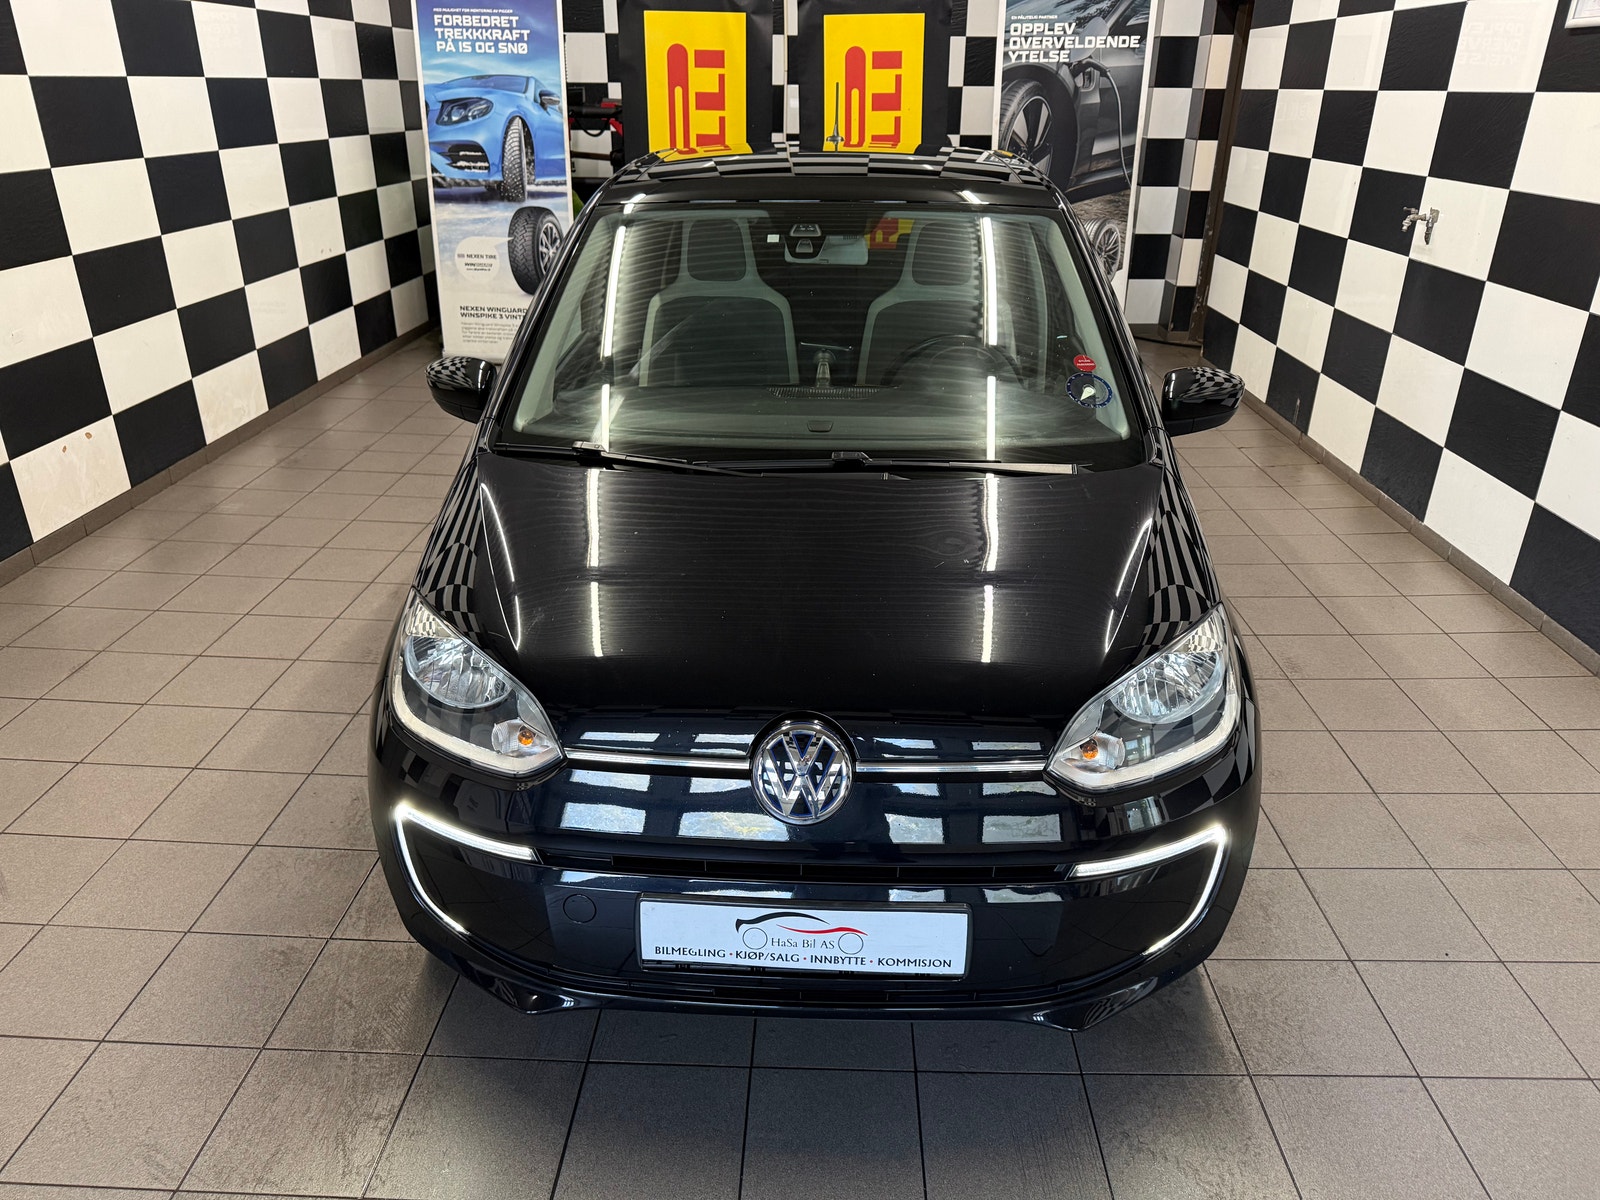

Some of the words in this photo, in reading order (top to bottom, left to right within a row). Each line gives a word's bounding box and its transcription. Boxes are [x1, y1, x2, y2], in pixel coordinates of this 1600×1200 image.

[434, 15, 519, 27] FORBEDRET
[435, 28, 530, 41] TREKKKRAFT
[1010, 23, 1076, 35] OPPLEV
[436, 38, 456, 52] PÅ
[459, 41, 472, 52] IS
[475, 42, 495, 53] OG
[498, 43, 528, 54] SNØ
[1009, 36, 1141, 48] OVERVELDENDE
[1008, 50, 1070, 62] YTELSE
[771, 937, 798, 948] HaSa
[802, 938, 816, 949] Bil
[820, 939, 835, 950] AS
[654, 946, 726, 958] BILMEGLING
[735, 951, 800, 963] KJØP/SALG
[810, 954, 867, 965] INNBYTTE
[877, 957, 952, 968] KOMMISJON
